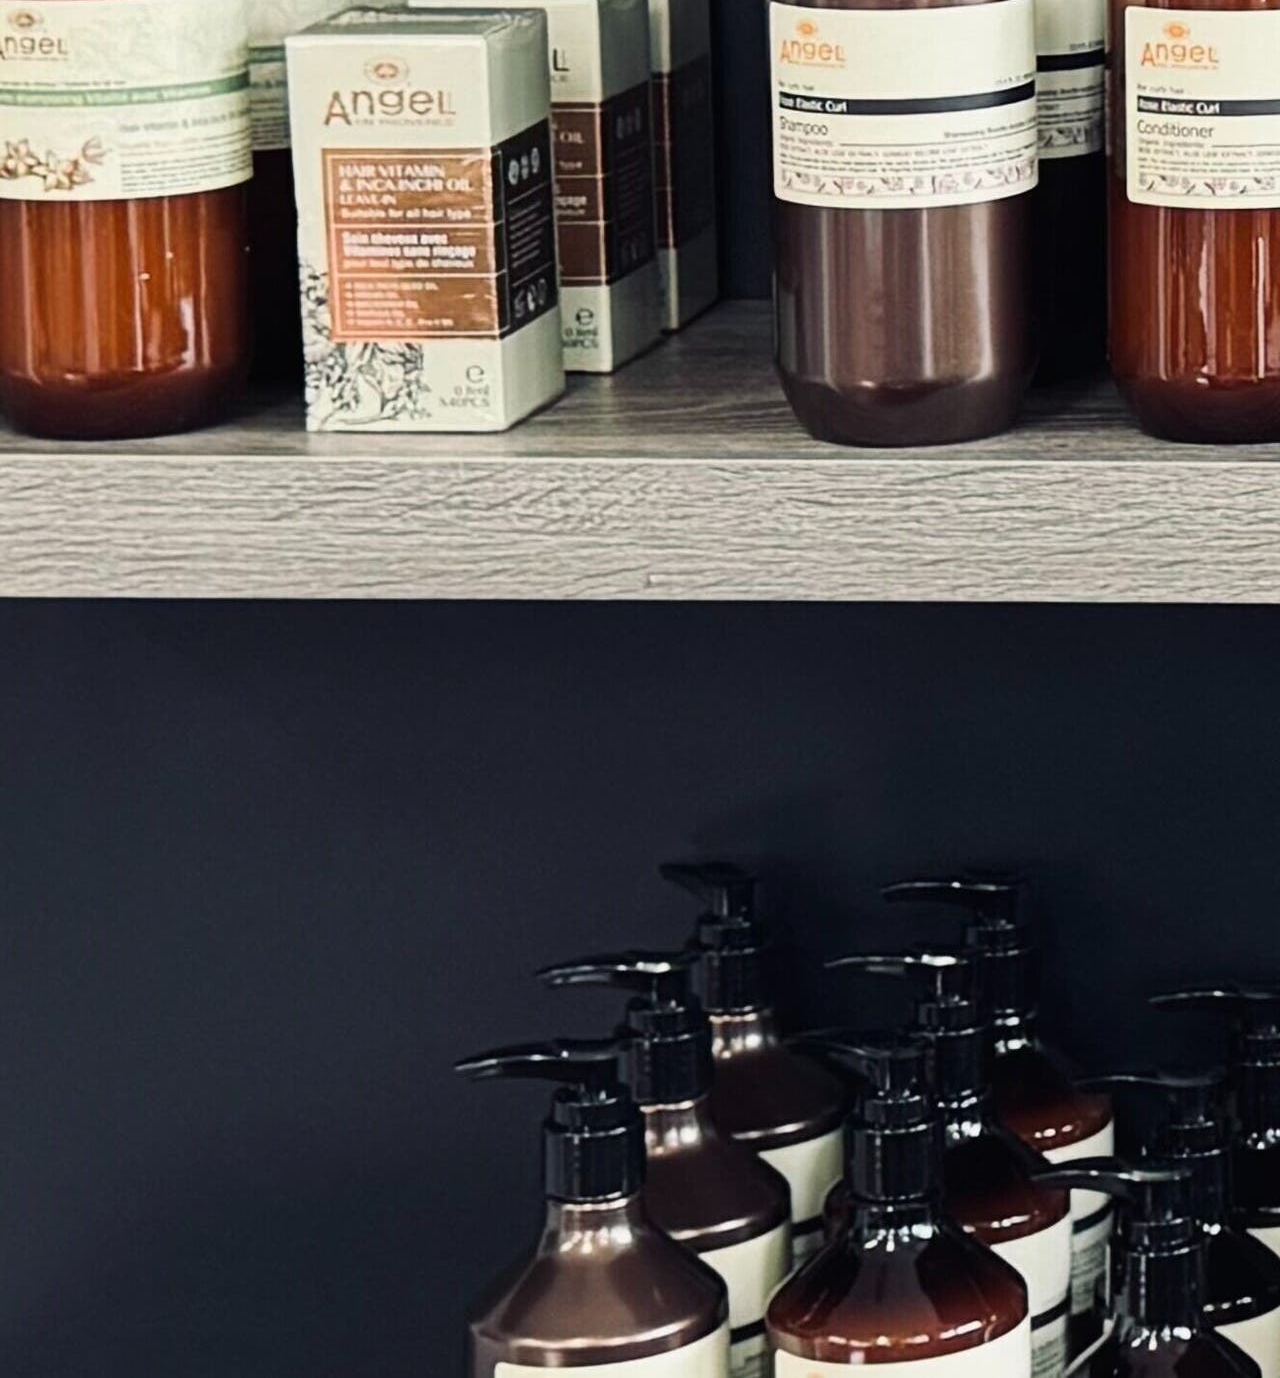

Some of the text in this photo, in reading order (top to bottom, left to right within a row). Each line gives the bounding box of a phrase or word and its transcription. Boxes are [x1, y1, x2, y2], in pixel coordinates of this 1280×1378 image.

[825, 100, 847, 113] Curl
[1161, 99, 1193, 113] Elastic
[1196, 101, 1220, 114] Curl
[1137, 119, 1216, 139] Conditioner
[340, 165, 445, 178] HAIR VITAMIN
[356, 179, 396, 192] INCA
[445, 178, 475, 192] OIL
[388, 208, 404, 219] for
[406, 208, 420, 218] all
[422, 208, 445, 219] hair
[370, 232, 418, 245] cheveux
